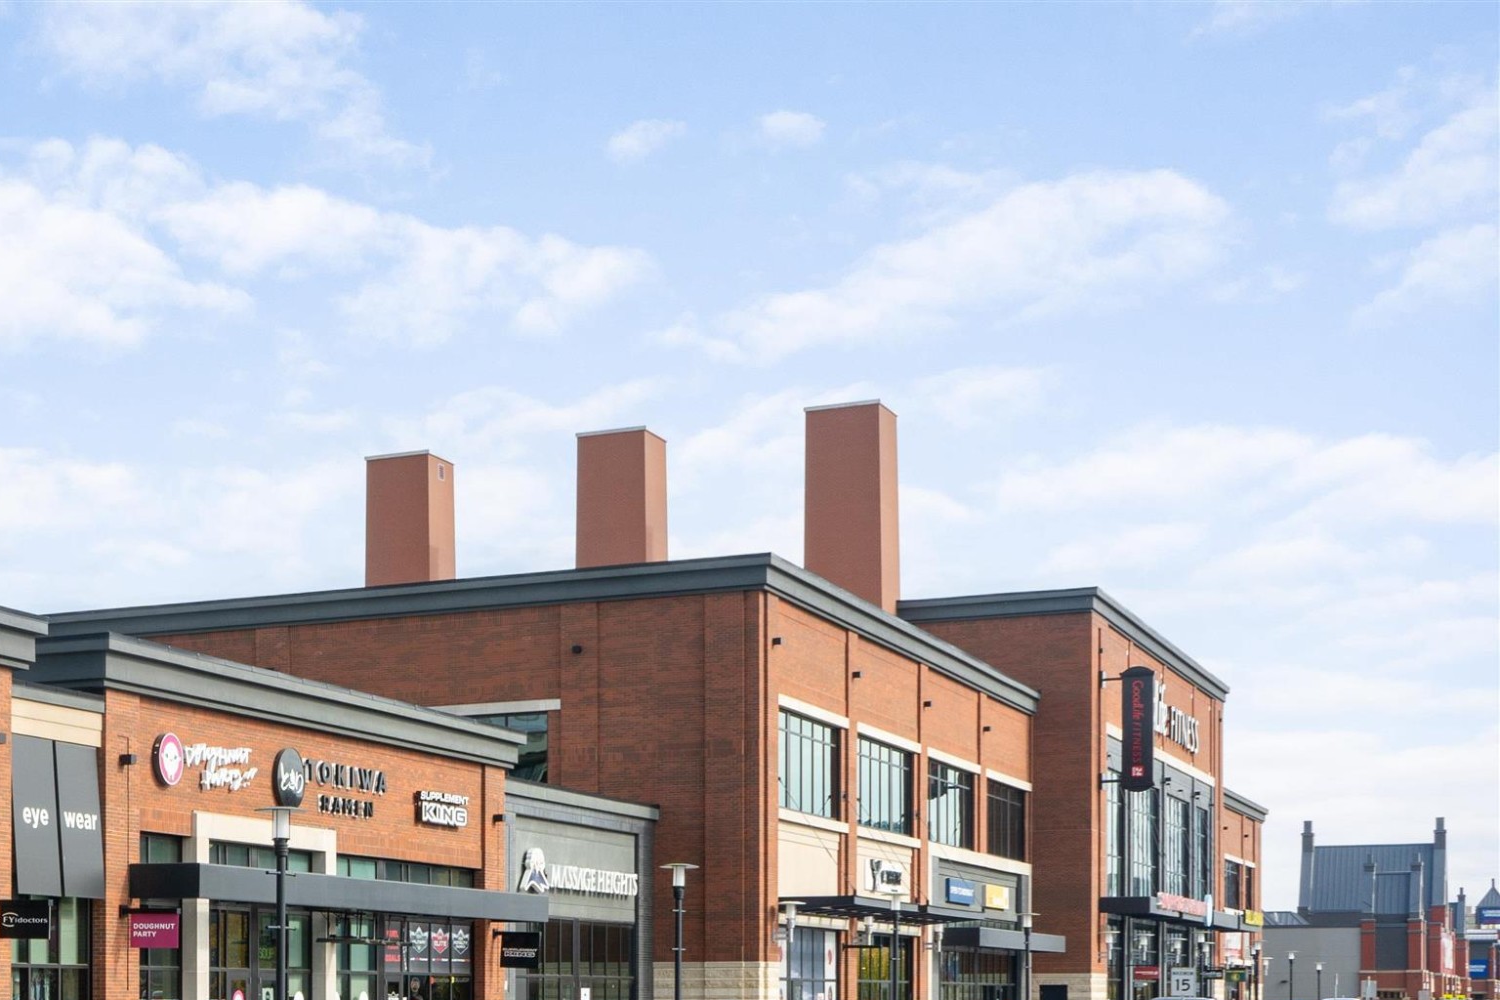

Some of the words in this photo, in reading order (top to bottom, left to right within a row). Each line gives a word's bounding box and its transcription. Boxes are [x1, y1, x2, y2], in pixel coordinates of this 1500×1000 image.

[1131, 721, 1142, 762] FITNESS
[1170, 706, 1200, 754] FITNESS
[302, 757, 388, 796] TOKIWA
[317, 794, 375, 819] RAMEN
[420, 790, 469, 805] SUPPLEMENT
[22, 804, 50, 829] eye
[64, 811, 97, 831] wear
[421, 802, 467, 827] KING
[550, 864, 597, 892] MASSAGE
[597, 869, 638, 897] HEIGHTS
[2, 913, 49, 927] FYidoctors
[133, 923, 175, 931] DOUGHNUT
[133, 931, 157, 939] PARTY
[1175, 978, 1191, 991] 15
